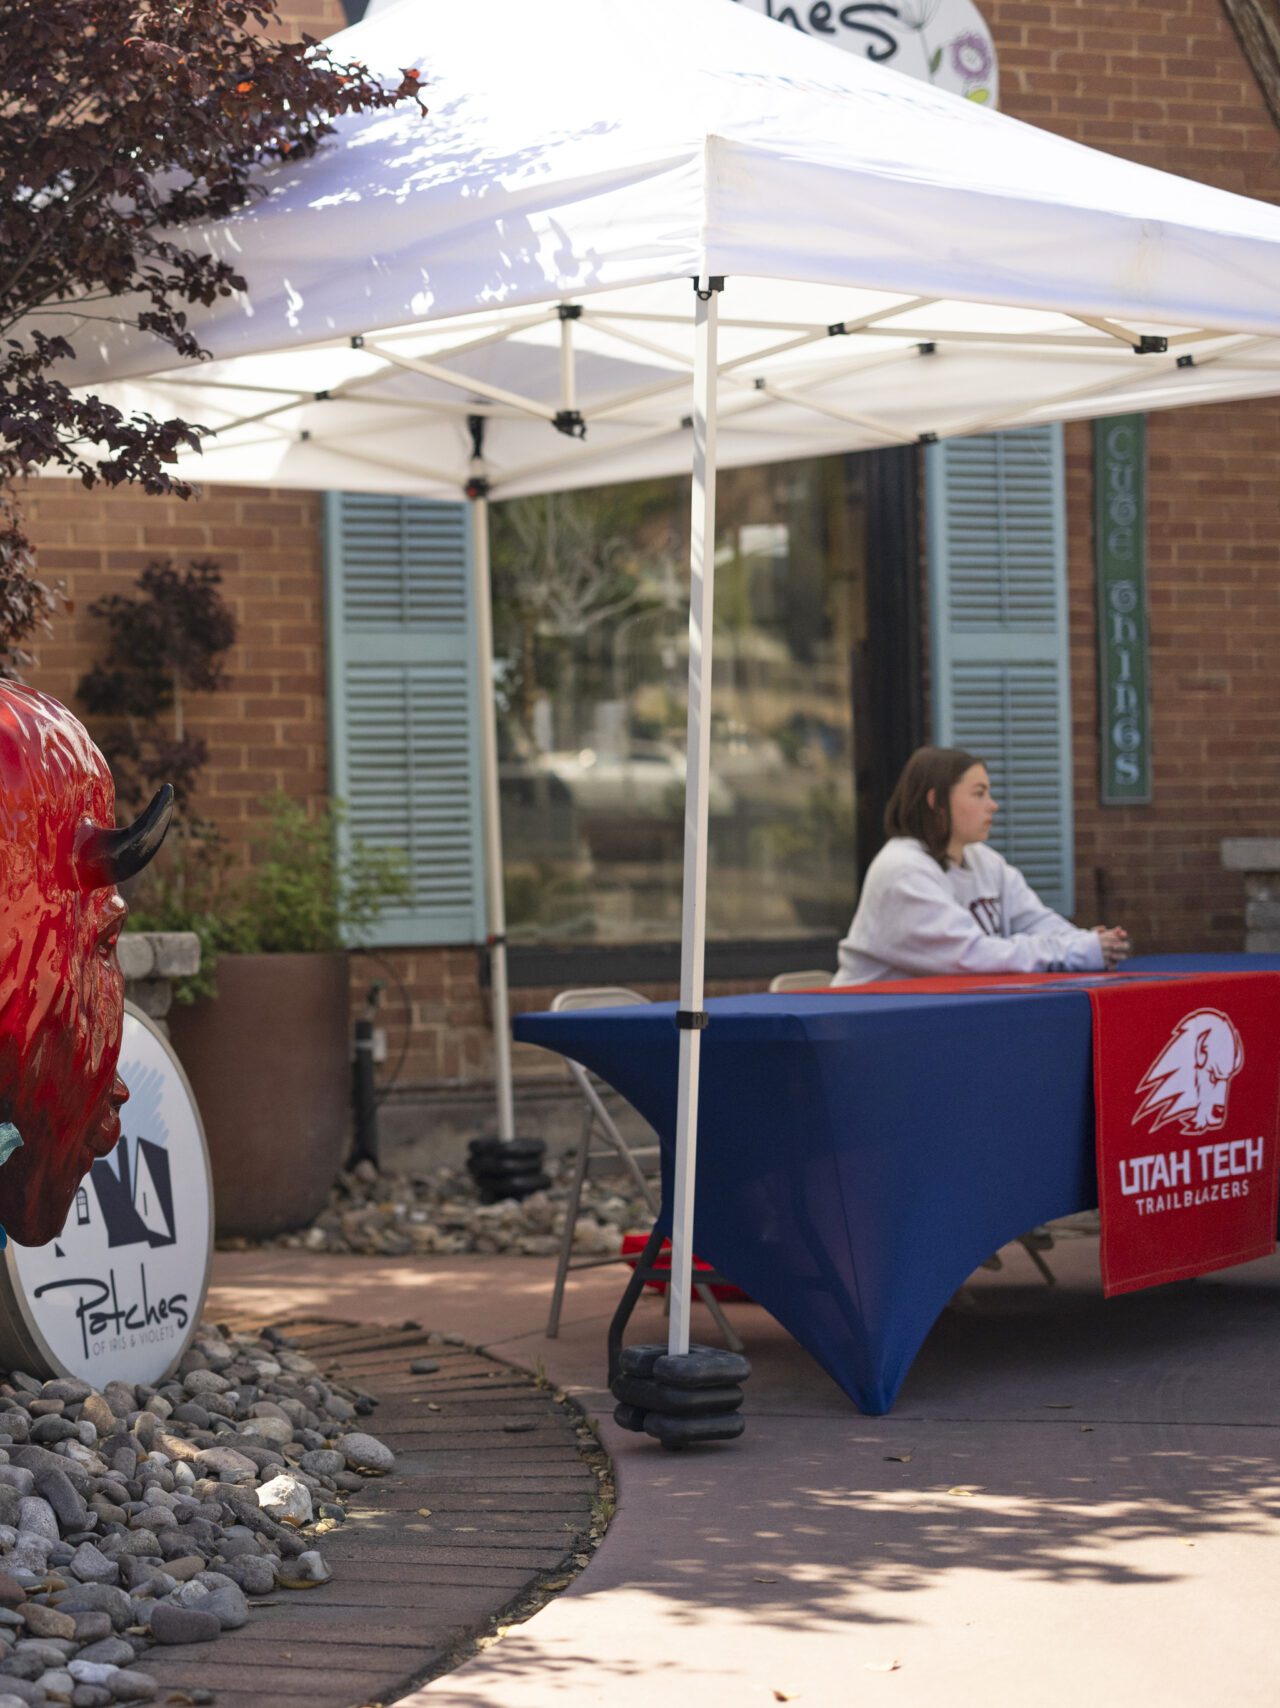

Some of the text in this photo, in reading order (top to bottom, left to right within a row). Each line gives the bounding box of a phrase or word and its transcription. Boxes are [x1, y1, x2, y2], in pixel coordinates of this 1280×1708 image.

[1118, 1136, 1264, 1197] UTAH TECH
[1135, 1179, 1250, 1217] TRAILBLAZERS
[34, 1262, 188, 1360] Patches
[93, 1341, 106, 1356] OF
[108, 1336, 127, 1353] IRIS
[139, 1325, 176, 1345] VIOLETS
